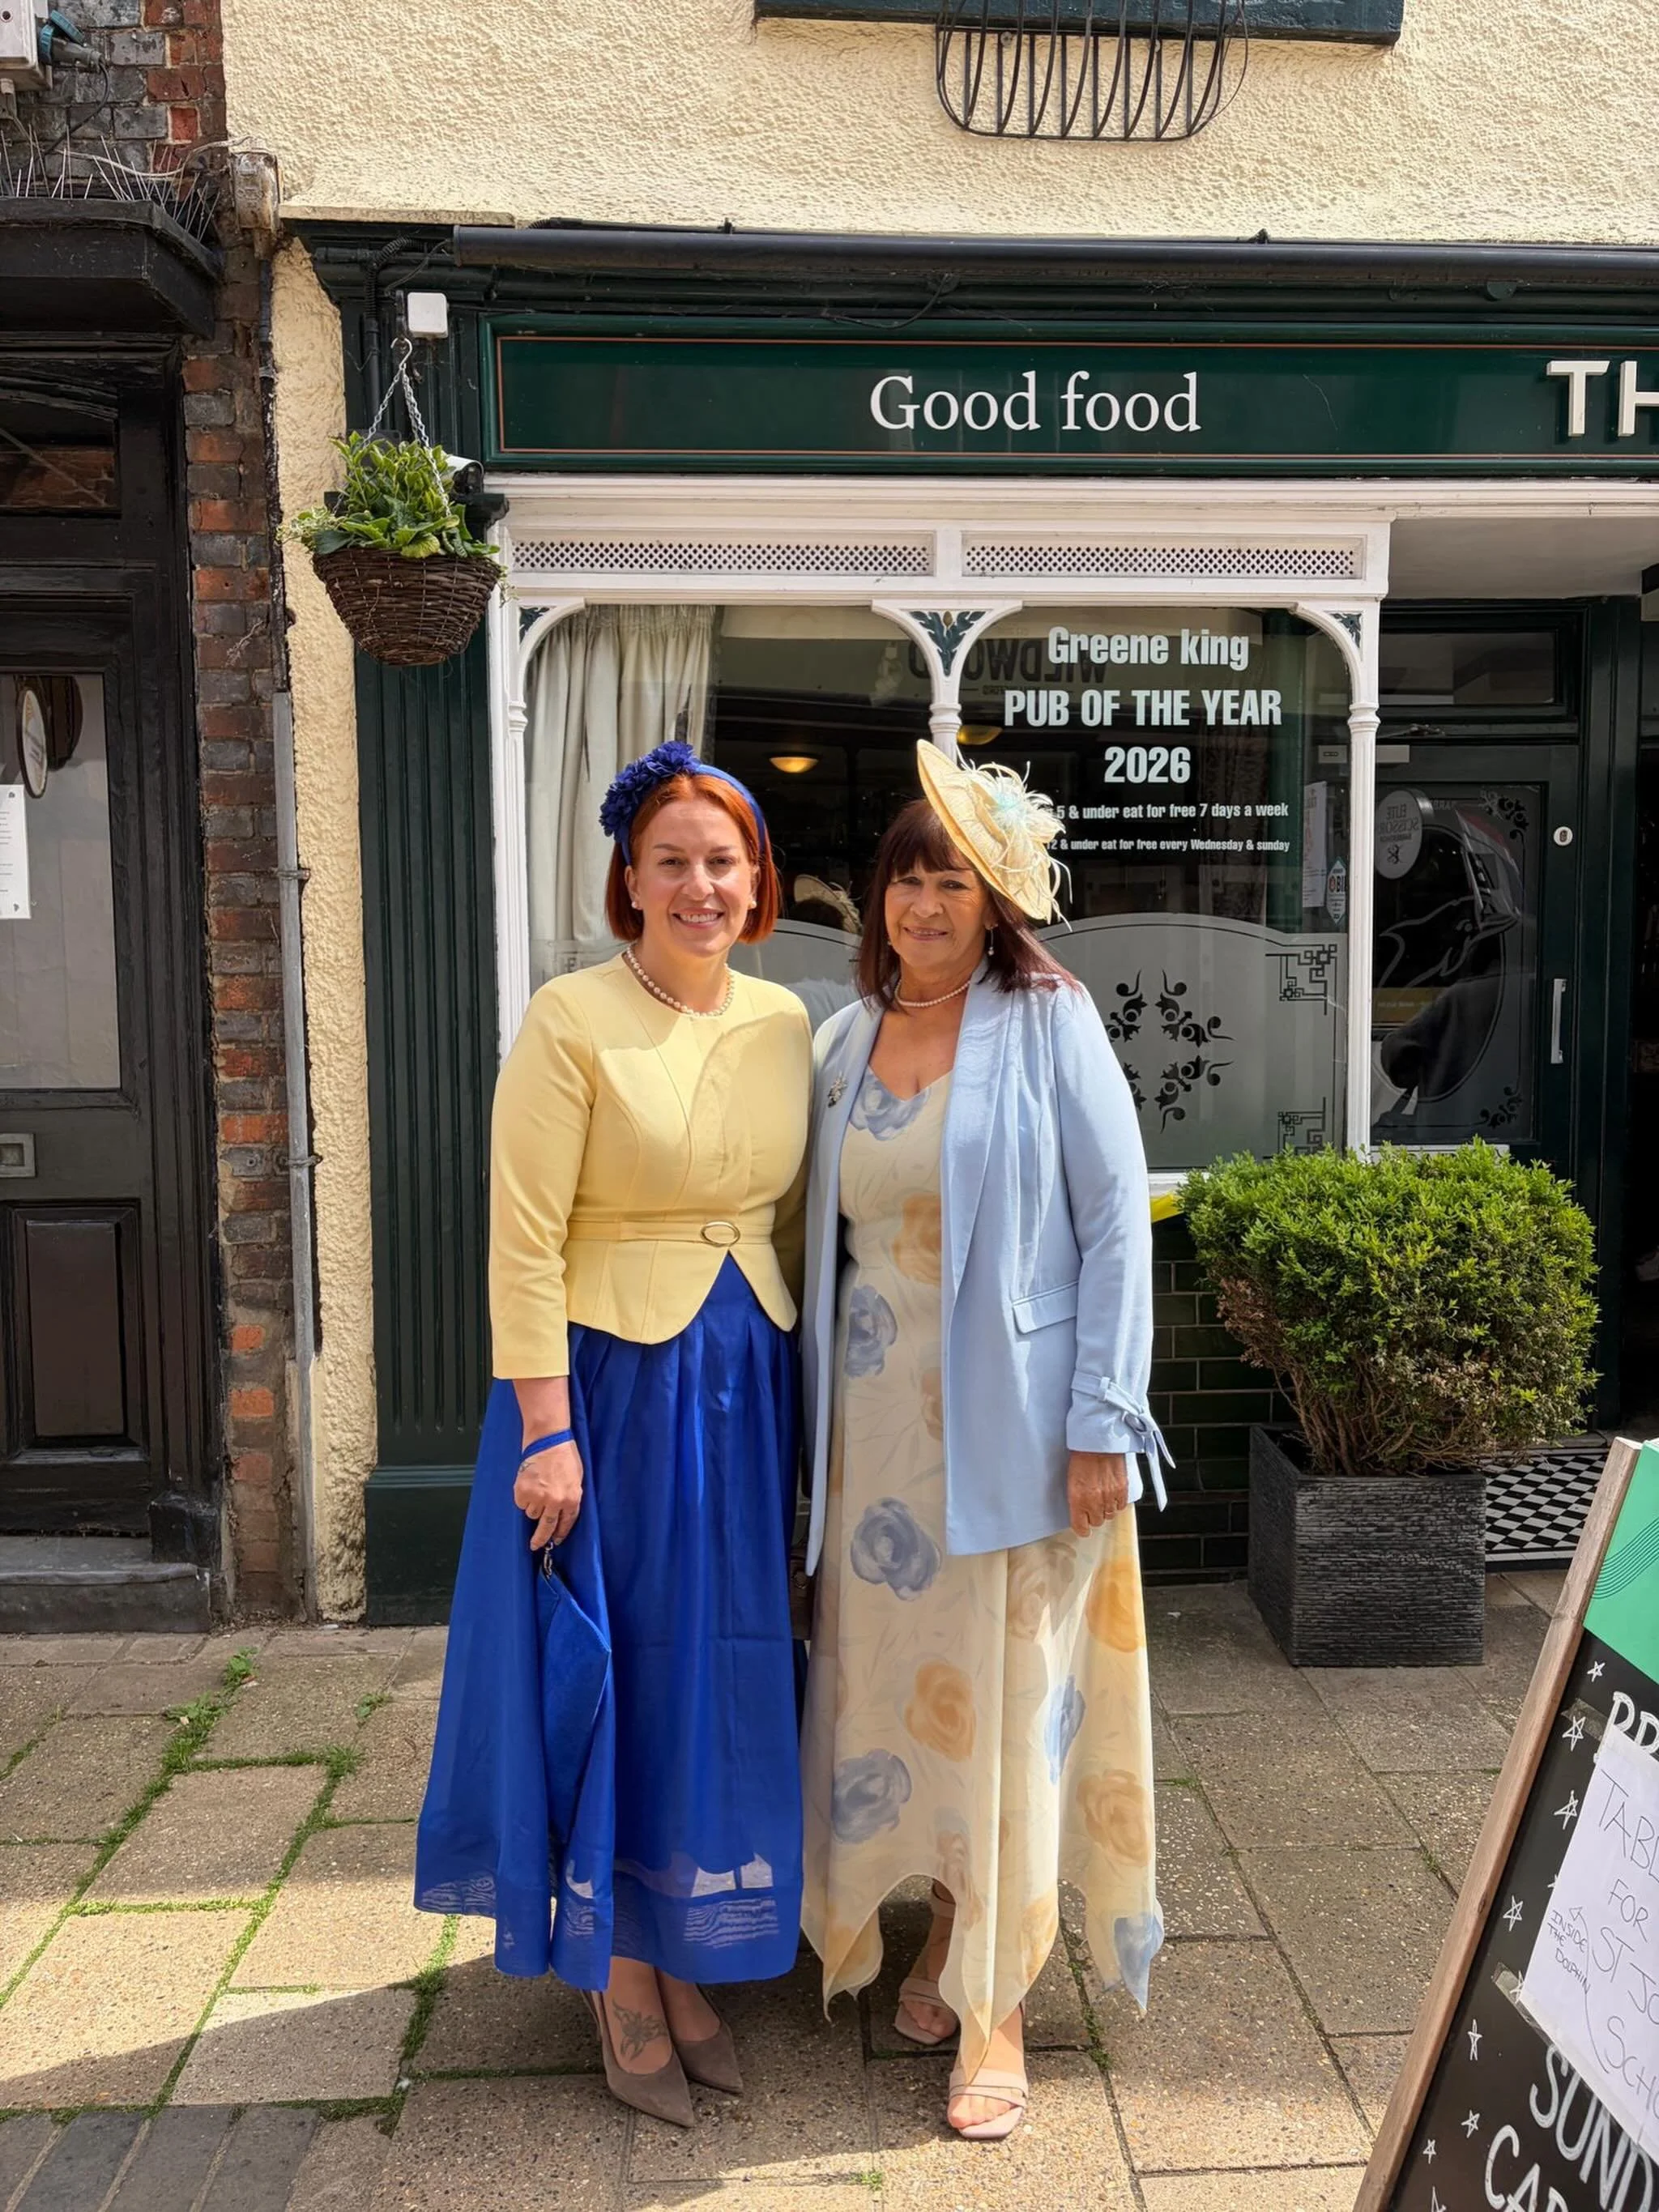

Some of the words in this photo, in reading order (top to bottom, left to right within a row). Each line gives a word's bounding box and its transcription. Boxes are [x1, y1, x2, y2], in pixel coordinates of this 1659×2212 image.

[871, 371, 1040, 431] Good
[1060, 371, 1201, 431] food
[1049, 627, 1168, 664] Greene
[1181, 629, 1248, 671] king
[1005, 690, 1069, 727] PUB
[1081, 690, 1120, 726] OF
[1132, 690, 1189, 726] THE
[1201, 690, 1281, 726] YEAR
[1105, 747, 1190, 782] 2026
[1069, 805, 1079, 819] &
[1083, 805, 1120, 819] under
[1123, 805, 1143, 819] eat
[1146, 804, 1166, 818] for
[1170, 803, 1196, 817] free
[1200, 803, 1208, 816] 7
[1211, 803, 1240, 819] days
[1244, 805, 1252, 816] a
[1256, 803, 1289, 816] week
[1060, 839, 1068, 850] &
[1071, 839, 1099, 850] under
[1101, 840, 1117, 850] eat
[1120, 839, 1134, 850] for
[1137, 839, 1157, 850] free
[1159, 840, 1188, 852] every
[1191, 839, 1243, 852] Wednesday
[1246, 840, 1255, 850] &
[1256, 839, 1290, 853] sunday
[1550, 1909, 1589, 1954] INSIDE
[1607, 1878, 1649, 1944] FOR
[1548, 1922, 1566, 1947] THE
[1591, 1926, 1635, 1984] ST
[1555, 1948, 1592, 1995] DOLPHIN
